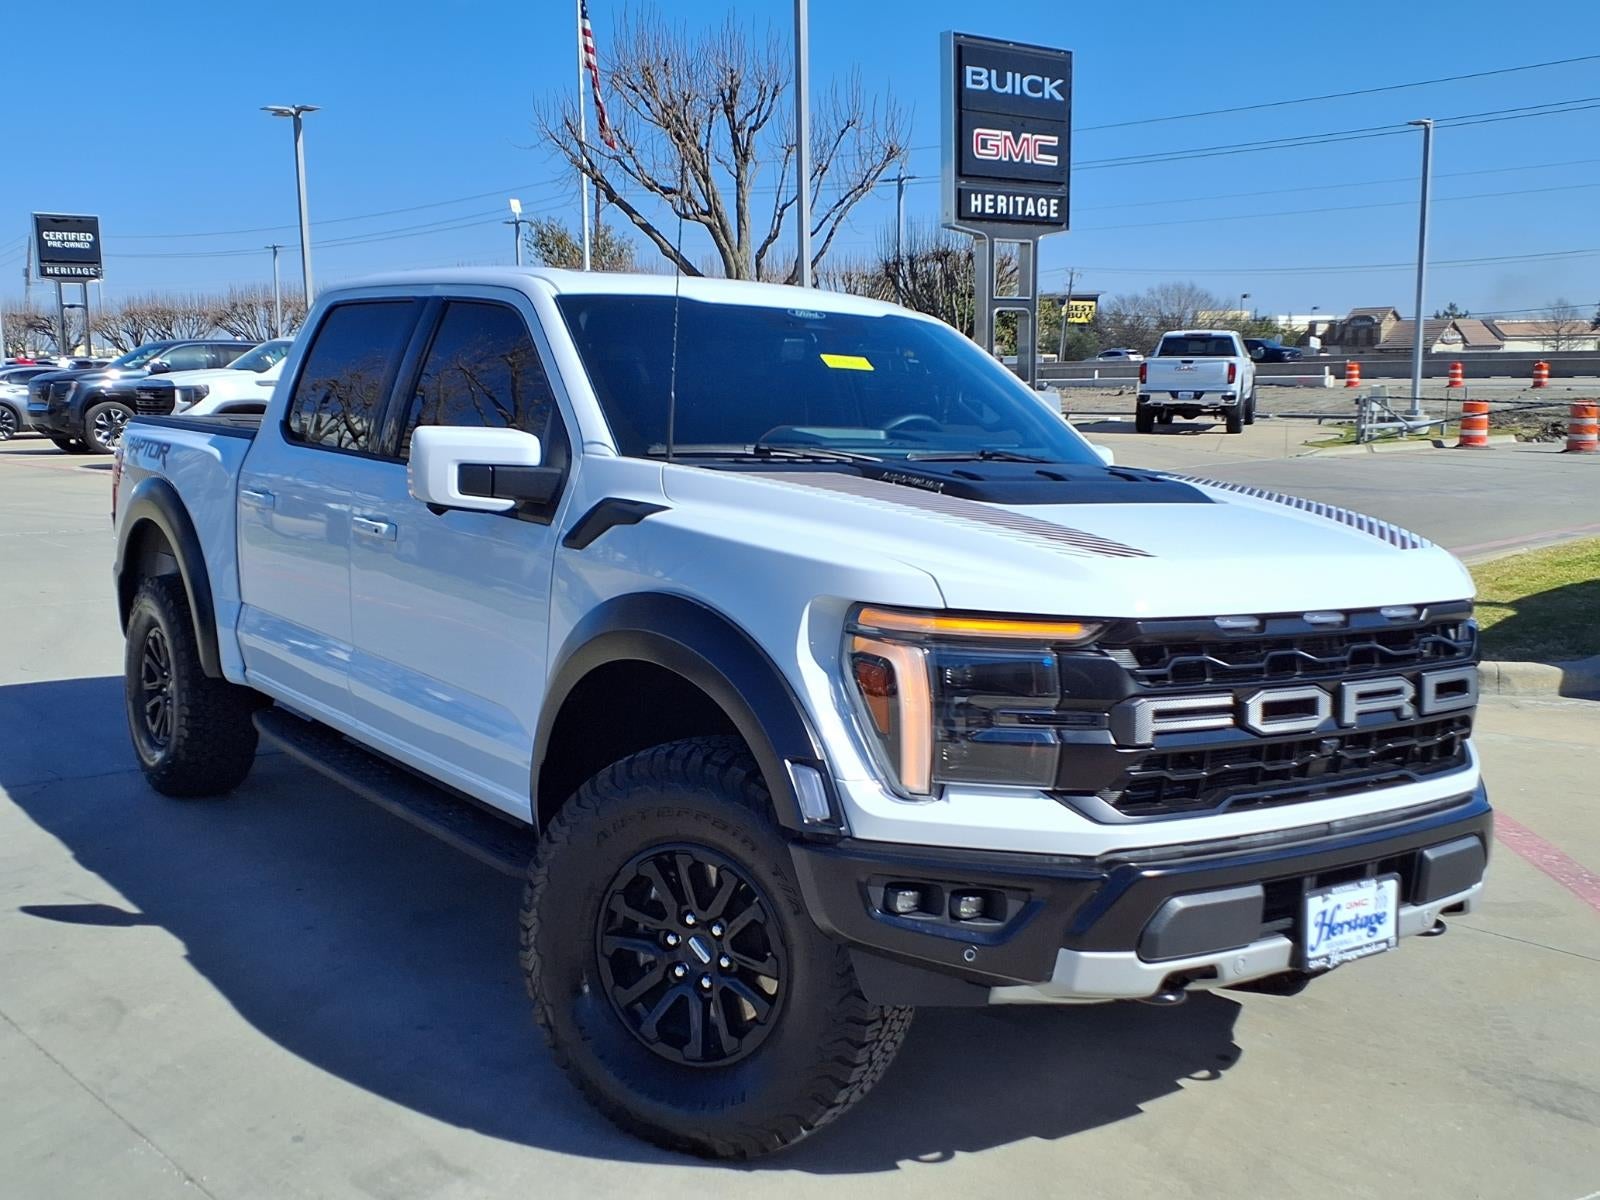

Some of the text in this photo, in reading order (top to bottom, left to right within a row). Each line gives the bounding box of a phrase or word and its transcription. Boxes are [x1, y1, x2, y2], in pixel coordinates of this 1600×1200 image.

[965, 65, 1065, 101] BUICK
[972, 128, 1059, 166] GMC
[970, 193, 1059, 217] HERITAGE
[43, 231, 94, 241] CERTIFIED
[47, 241, 90, 249] PRE-OWNED
[1067, 312, 1090, 320] BUY
[1068, 304, 1094, 312] BEST
[127, 435, 172, 470] RAPTOR
[1132, 665, 1480, 746] FORD
[1309, 903, 1387, 950] Heritage
